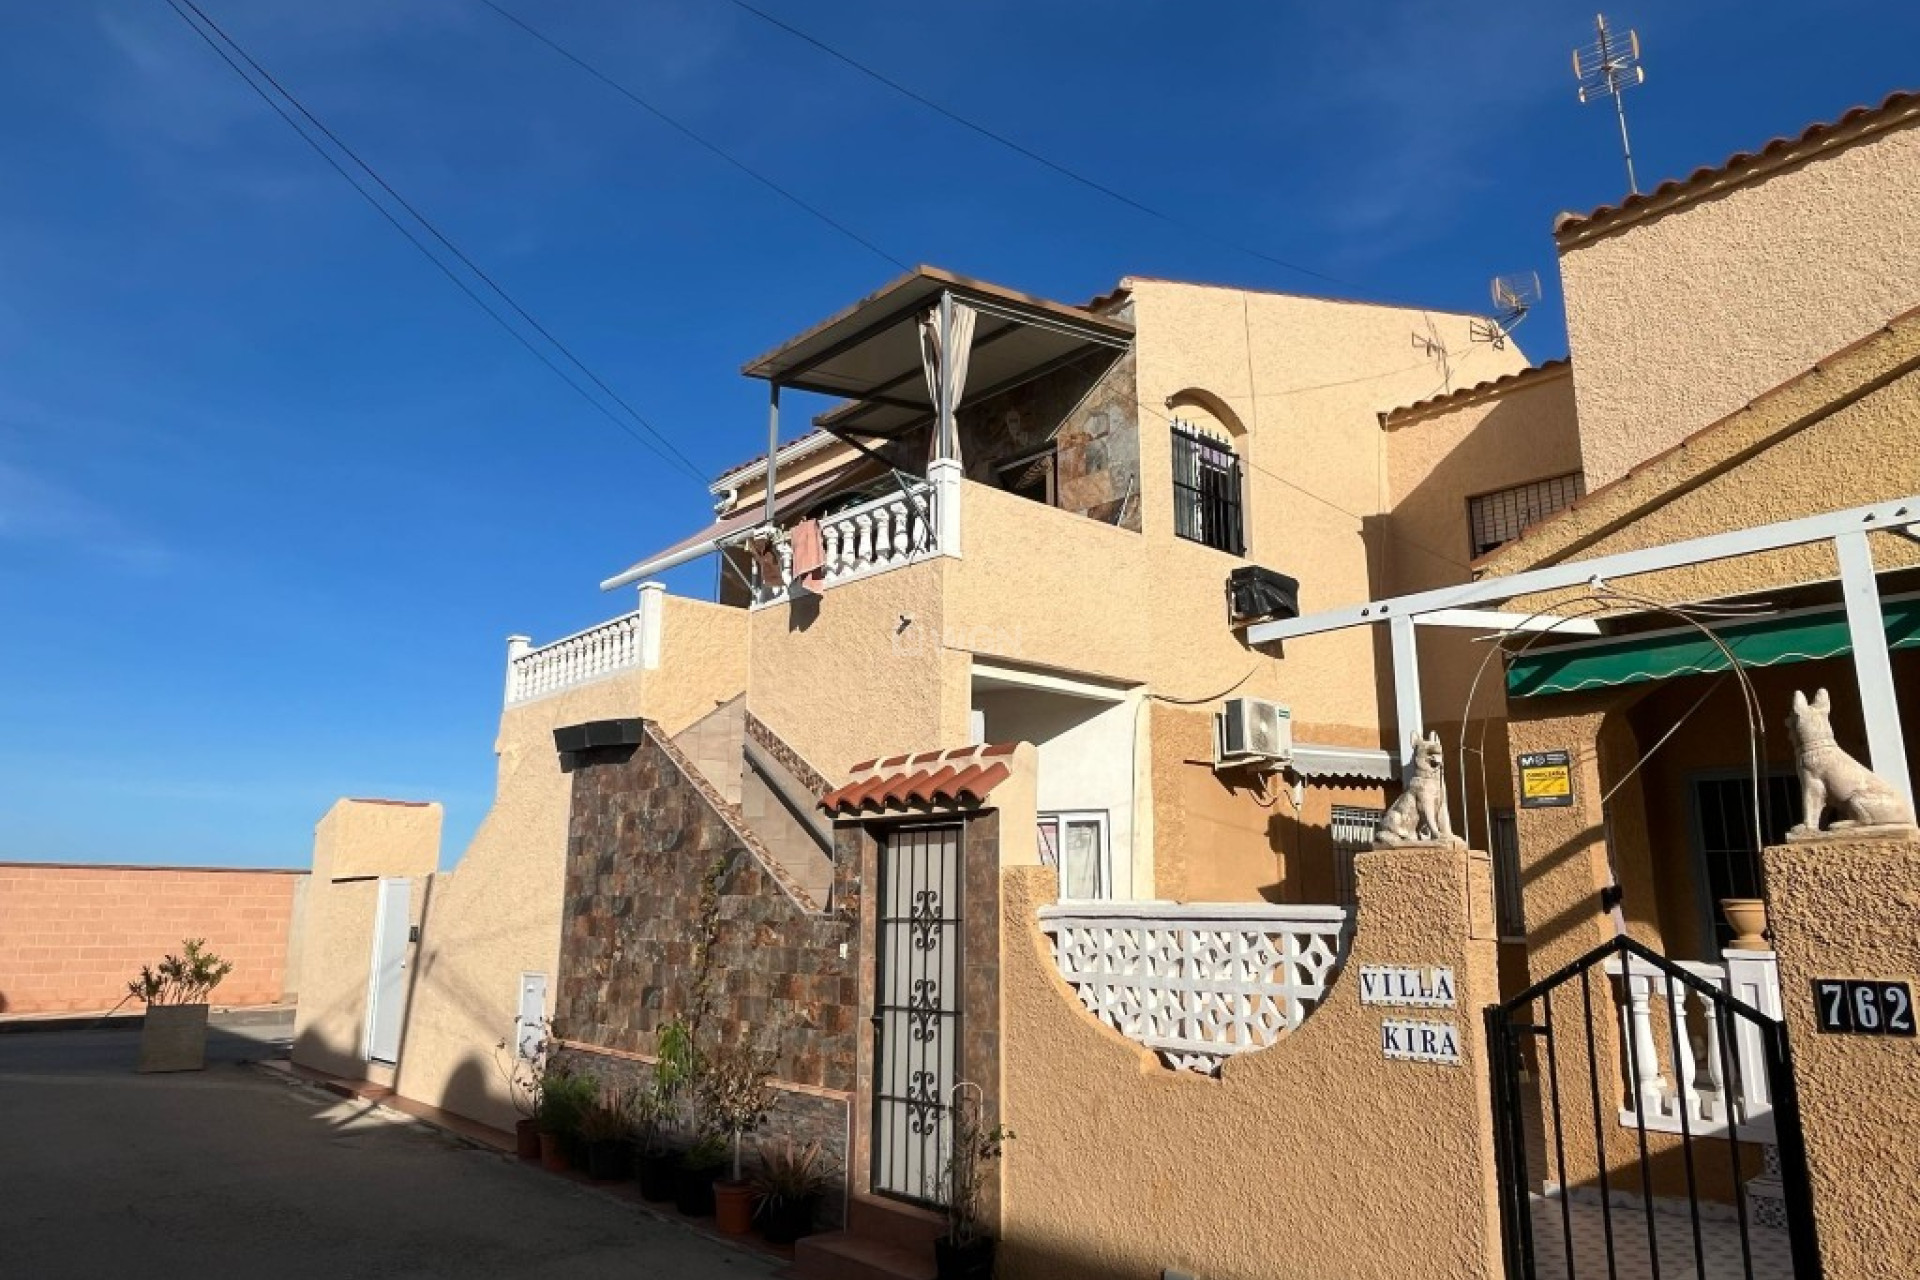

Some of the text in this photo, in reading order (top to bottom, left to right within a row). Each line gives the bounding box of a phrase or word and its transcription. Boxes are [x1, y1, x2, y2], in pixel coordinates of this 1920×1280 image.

[1361, 973, 1454, 999] VILLA
[1822, 984, 1910, 1030] 762
[1382, 1025, 1459, 1056] KIRA
